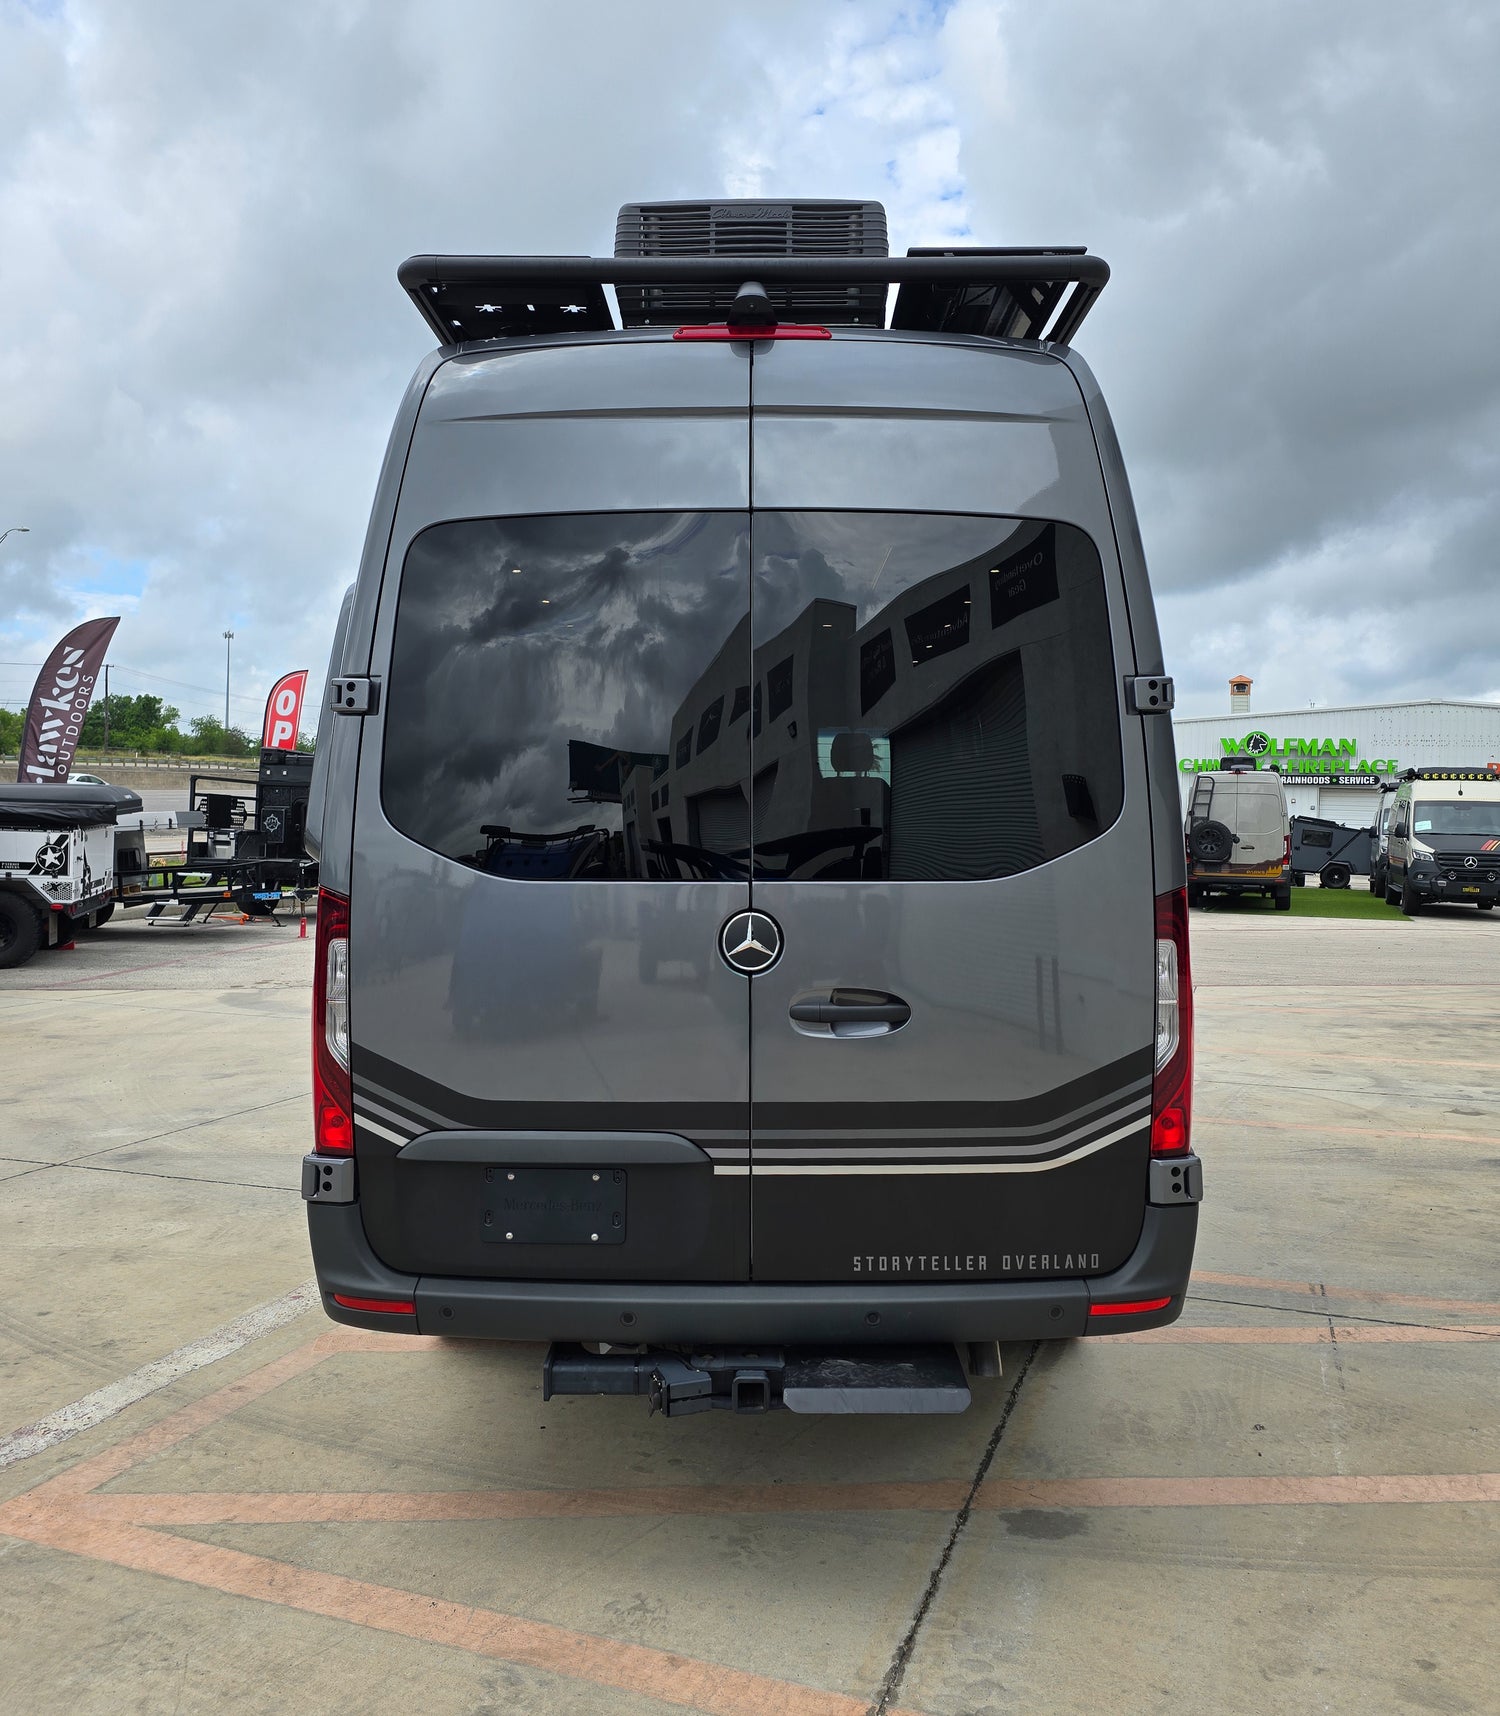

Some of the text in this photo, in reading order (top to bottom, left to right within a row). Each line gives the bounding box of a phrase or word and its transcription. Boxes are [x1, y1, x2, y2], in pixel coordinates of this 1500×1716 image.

[57, 675, 94, 775] OUTDOORS
[1220, 730, 1357, 757] WOLFMAN
[1178, 758, 1265, 773] CHIY
[1287, 759, 1399, 775] FIREPLACE
[1282, 775, 1376, 785] RAINHOODS SERVICE
[853, 1253, 1099, 1271] STORYTELLER OVERLAND
